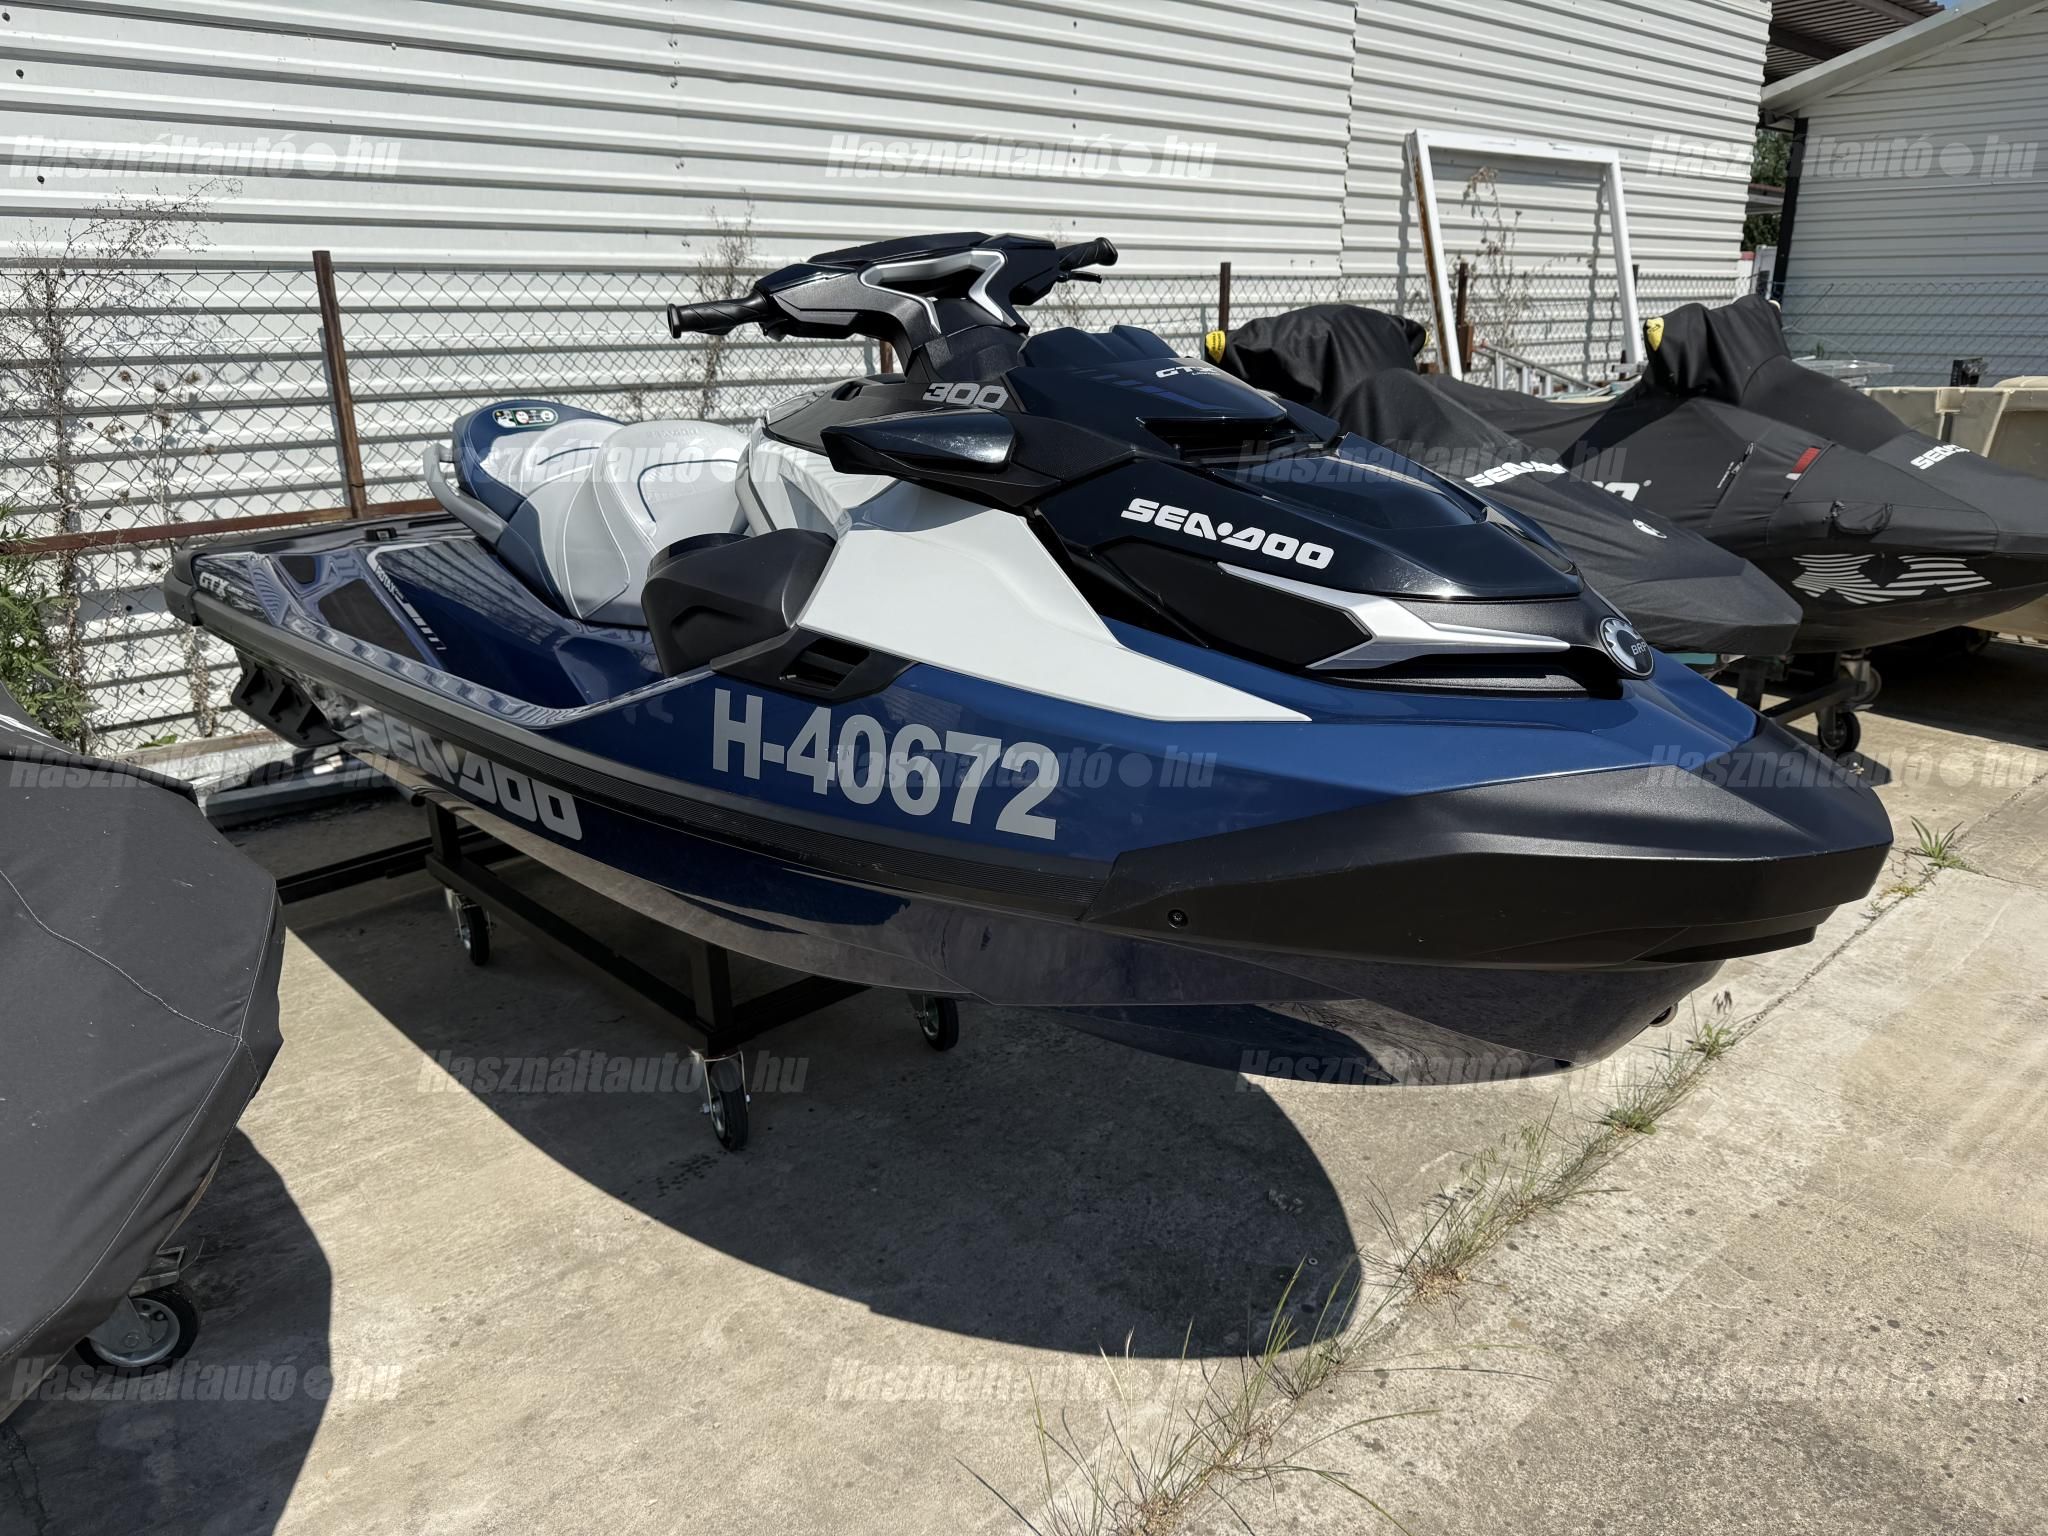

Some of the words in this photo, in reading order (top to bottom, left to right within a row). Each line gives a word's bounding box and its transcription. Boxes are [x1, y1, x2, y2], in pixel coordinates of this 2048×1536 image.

[922, 382, 1009, 410] 300
[200, 571, 229, 598] GTX
[713, 687, 1060, 841] H-40672
